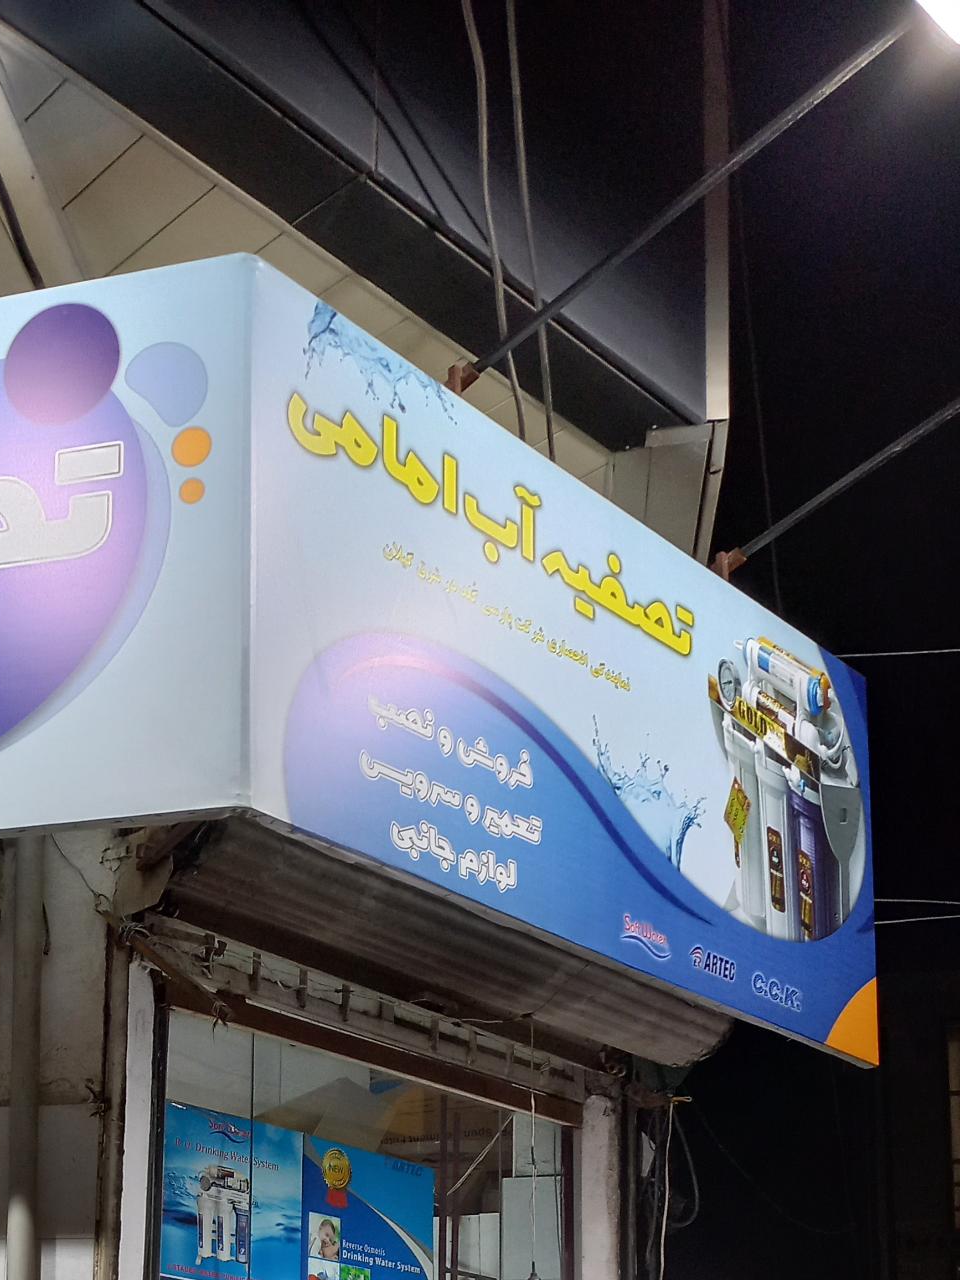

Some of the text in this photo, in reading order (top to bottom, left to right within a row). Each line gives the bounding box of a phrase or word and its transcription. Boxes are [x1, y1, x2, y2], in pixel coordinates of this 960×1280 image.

[287, 391, 696, 658] تصفیه آب امامی
[739, 698, 767, 737] GOLD
[368, 694, 533, 790] فروش و نصب
[359, 749, 543, 845] تعمیر و سرویس
[390, 820, 518, 893] لوازم جانبی
[703, 951, 736, 982] ARTEC
[195, 1143, 228, 1161] Drinking
[230, 1151, 251, 1164] Wate
[253, 1157, 279, 1171] System
[342, 1239, 364, 1252] Reverse
[342, 1249, 421, 1274] Drinking Water System
